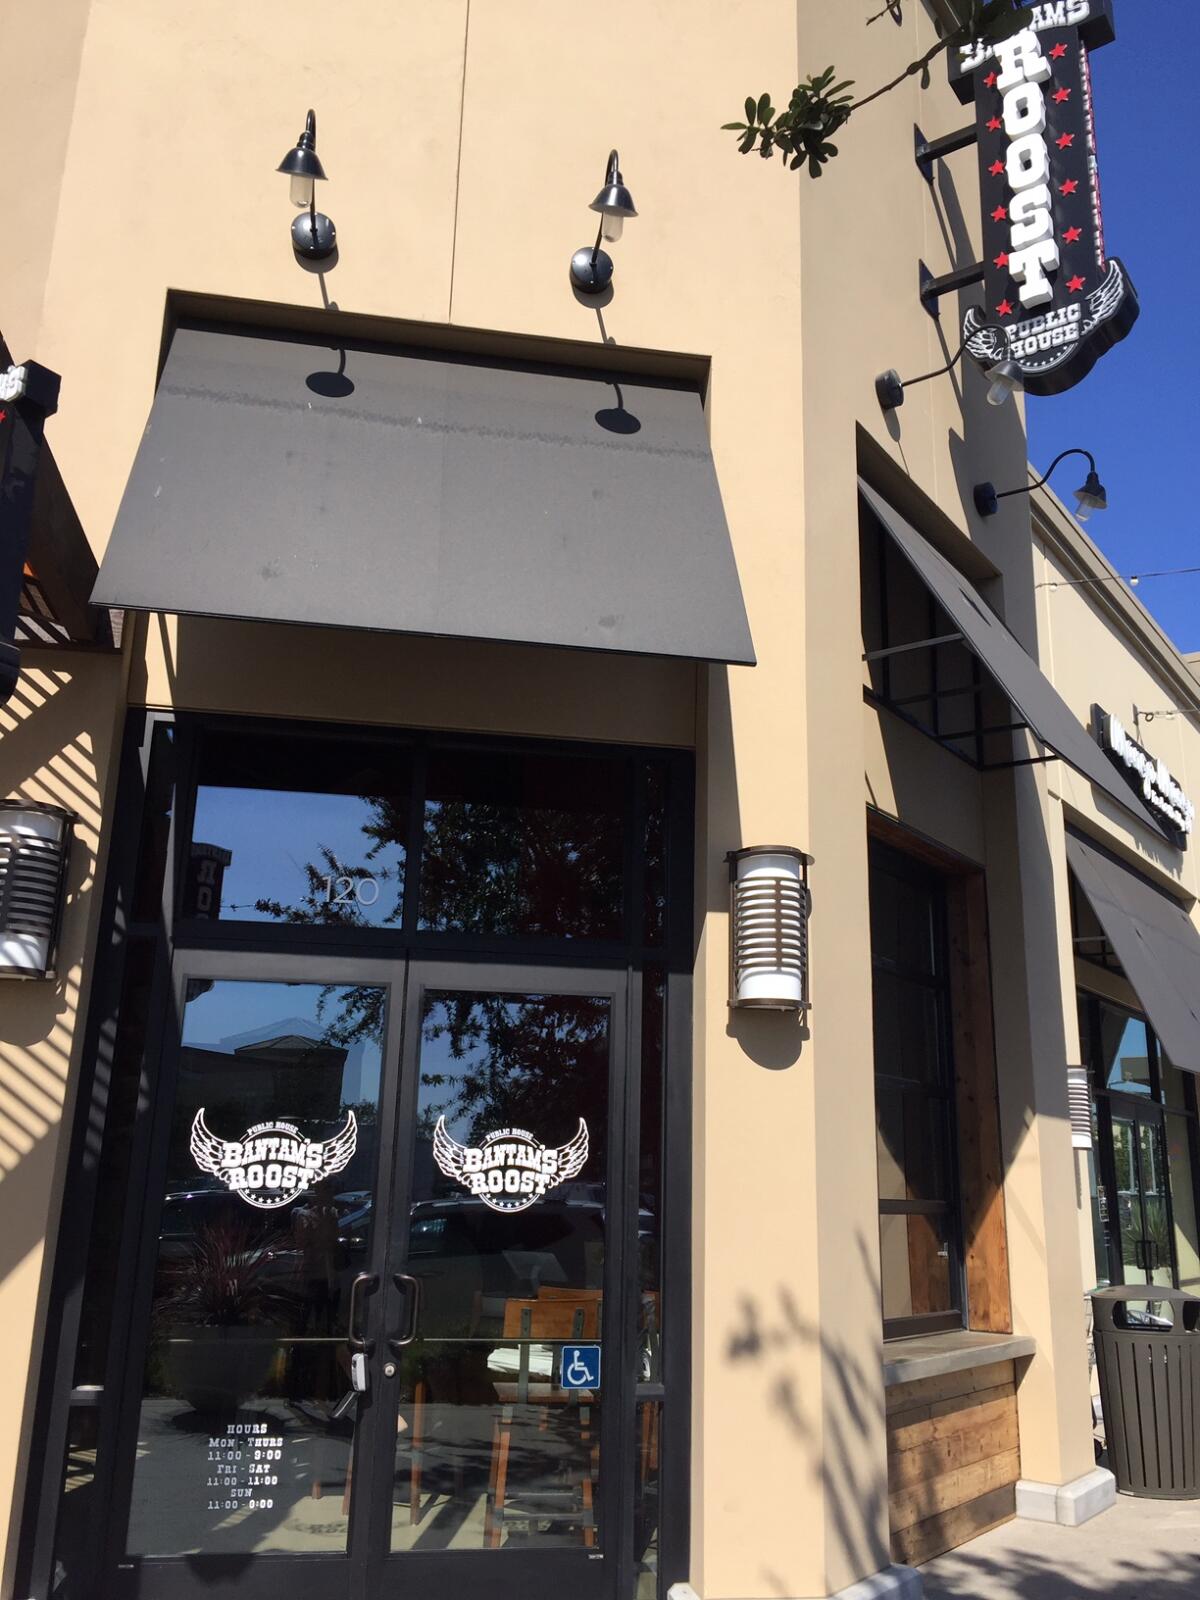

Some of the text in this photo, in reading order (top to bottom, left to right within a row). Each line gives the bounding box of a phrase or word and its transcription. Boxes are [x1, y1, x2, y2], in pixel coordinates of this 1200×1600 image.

[993, 28, 1061, 310] ROOST
[1004, 302, 1081, 343] PUBLIC
[1010, 322, 1080, 359] HOUSE
[322, 875, 380, 905] 120
[247, 1121, 299, 1136] PUBLIC HOUSE
[485, 1127, 534, 1141] PUBLIC HOUSE
[221, 1137, 324, 1169] BANTAM'S
[462, 1143, 558, 1174] BANTAM'S
[228, 1163, 315, 1191] ROOST
[470, 1168, 551, 1195] ROOST
[226, 1423, 268, 1434] HOURS
[208, 1437, 236, 1448] MON
[247, 1437, 284, 1447] THURS
[207, 1451, 242, 1461] 11:00
[216, 1464, 238, 1474] FRI
[248, 1463, 271, 1474] SAT
[206, 1477, 238, 1486] 11:00
[247, 1475, 278, 1486] 11:00
[230, 1488, 253, 1497] SUN
[207, 1500, 238, 1509] 11:00
